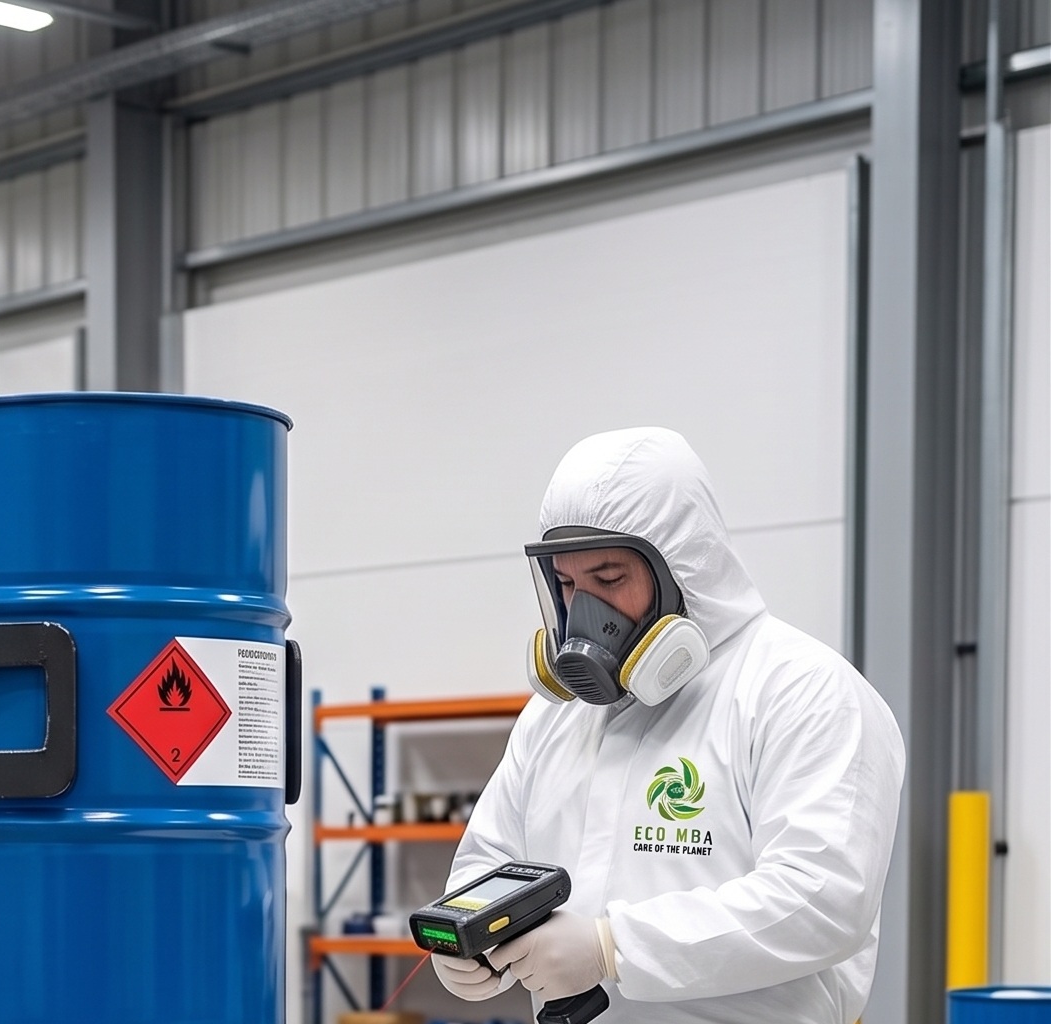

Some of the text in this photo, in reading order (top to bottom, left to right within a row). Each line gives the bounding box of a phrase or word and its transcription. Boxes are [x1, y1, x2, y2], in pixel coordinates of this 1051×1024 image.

[170, 748, 181, 763] 2
[634, 826, 713, 846] ECO MBA
[633, 843, 712, 856] CARE OF THE PLANET
